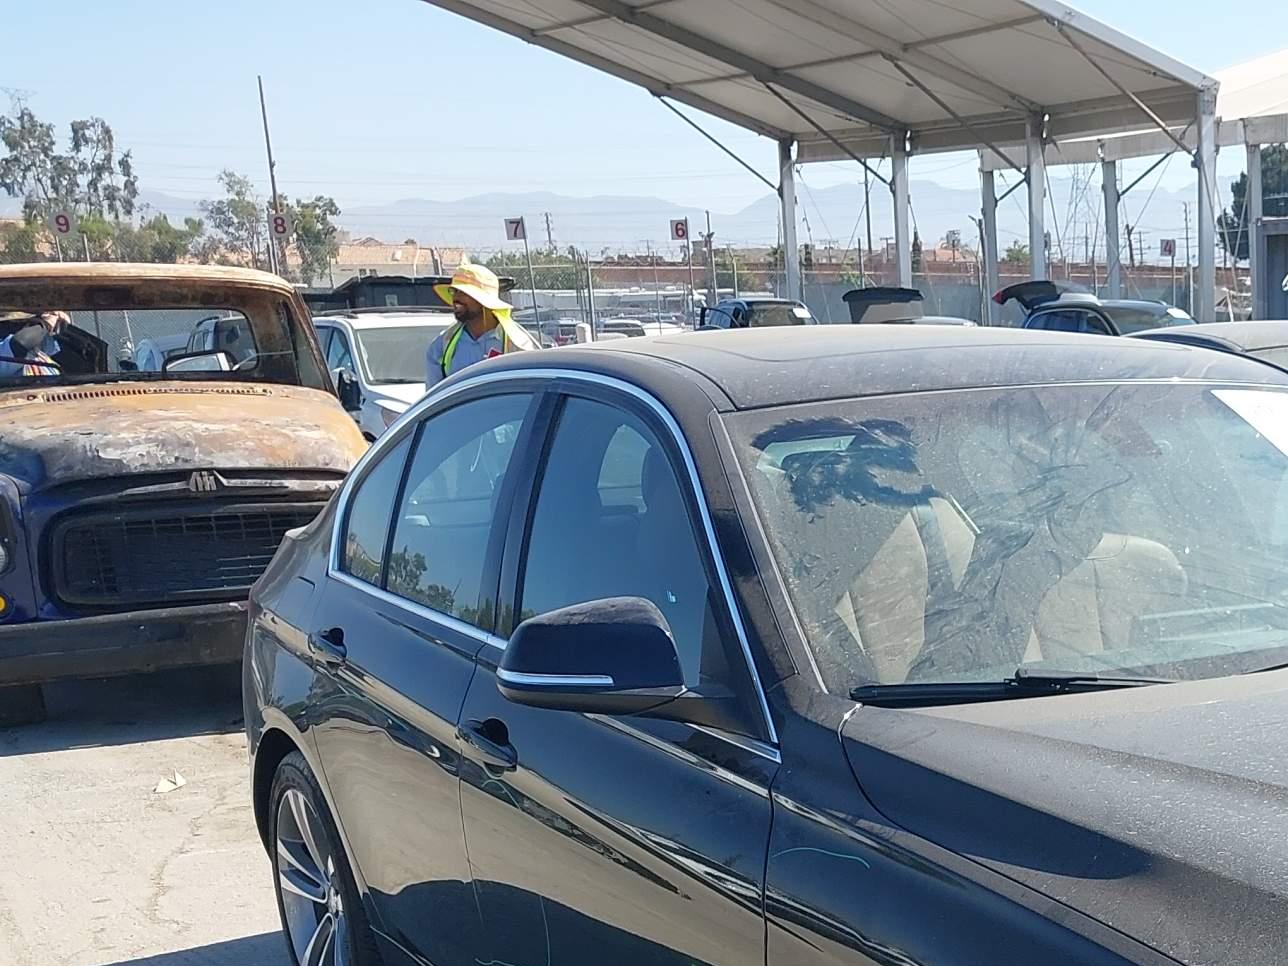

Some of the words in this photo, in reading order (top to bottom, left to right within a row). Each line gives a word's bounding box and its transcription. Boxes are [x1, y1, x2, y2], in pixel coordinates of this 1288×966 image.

[55, 214, 71, 233] 9
[273, 216, 287, 234] 8
[509, 220, 521, 238] 7
[675, 222, 686, 238] 6
[1163, 240, 1172, 256] 4
